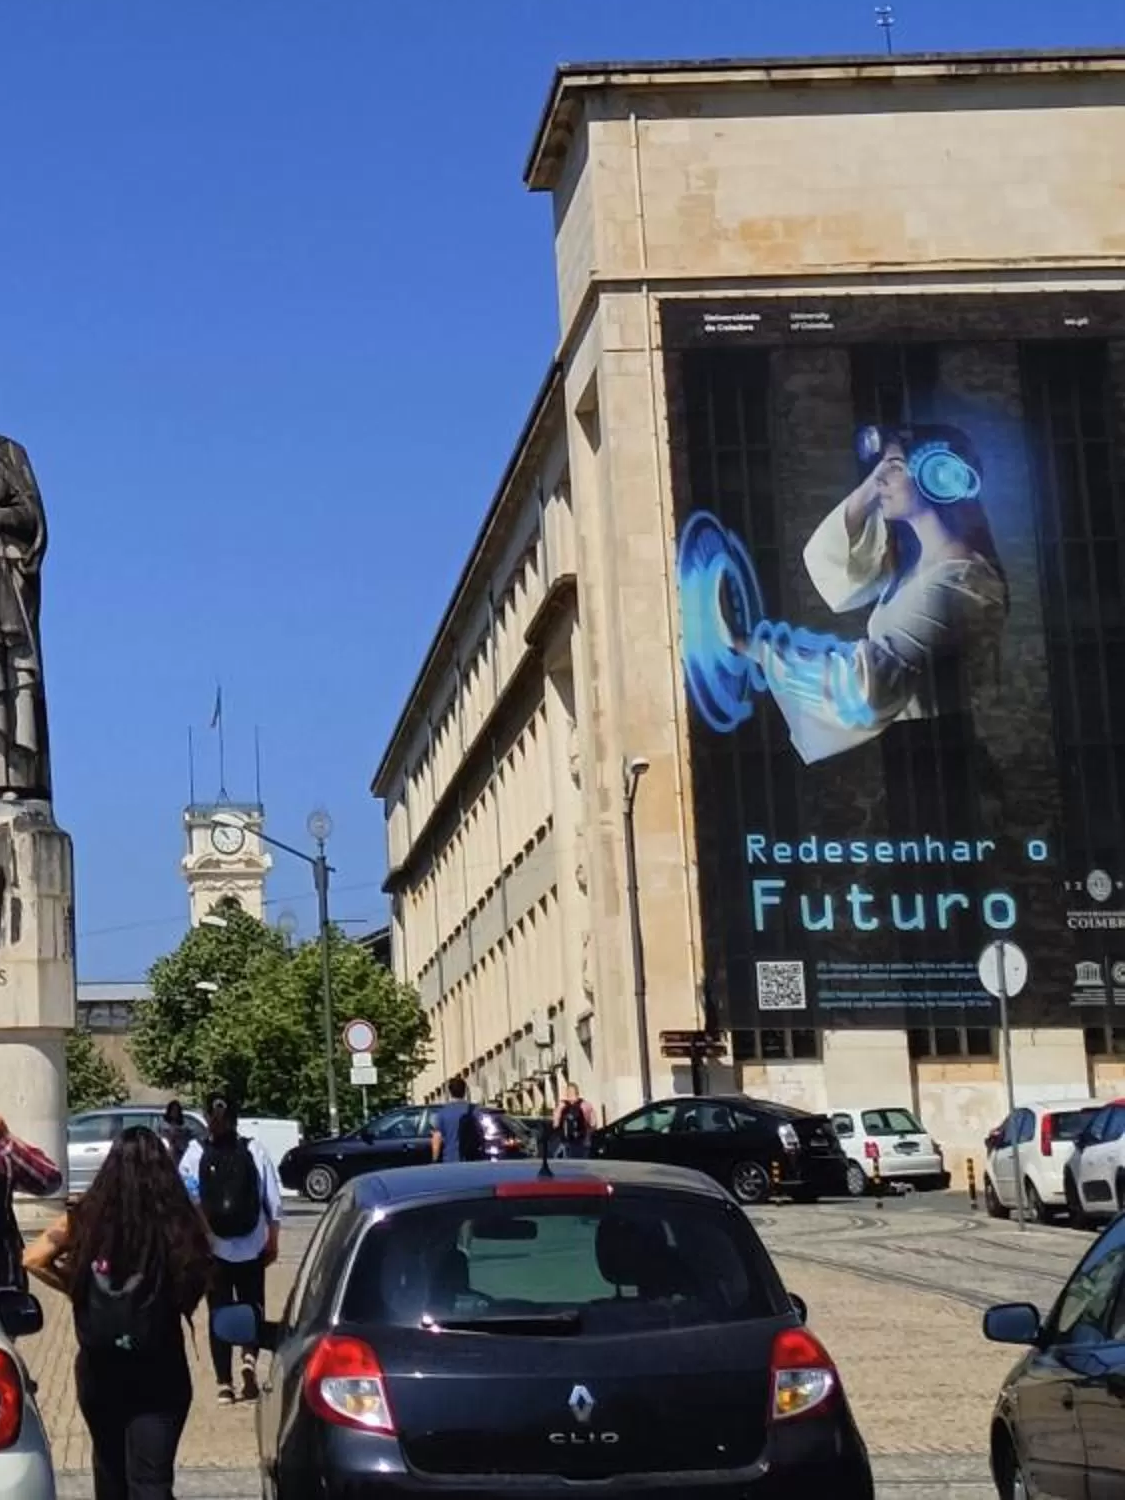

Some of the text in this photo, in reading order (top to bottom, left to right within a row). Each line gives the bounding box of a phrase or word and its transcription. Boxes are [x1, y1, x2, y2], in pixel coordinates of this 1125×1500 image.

[746, 833, 1048, 864] Redesenhar o
[751, 878, 1017, 932] Futuro
[548, 1431, 620, 1444] CLIO
